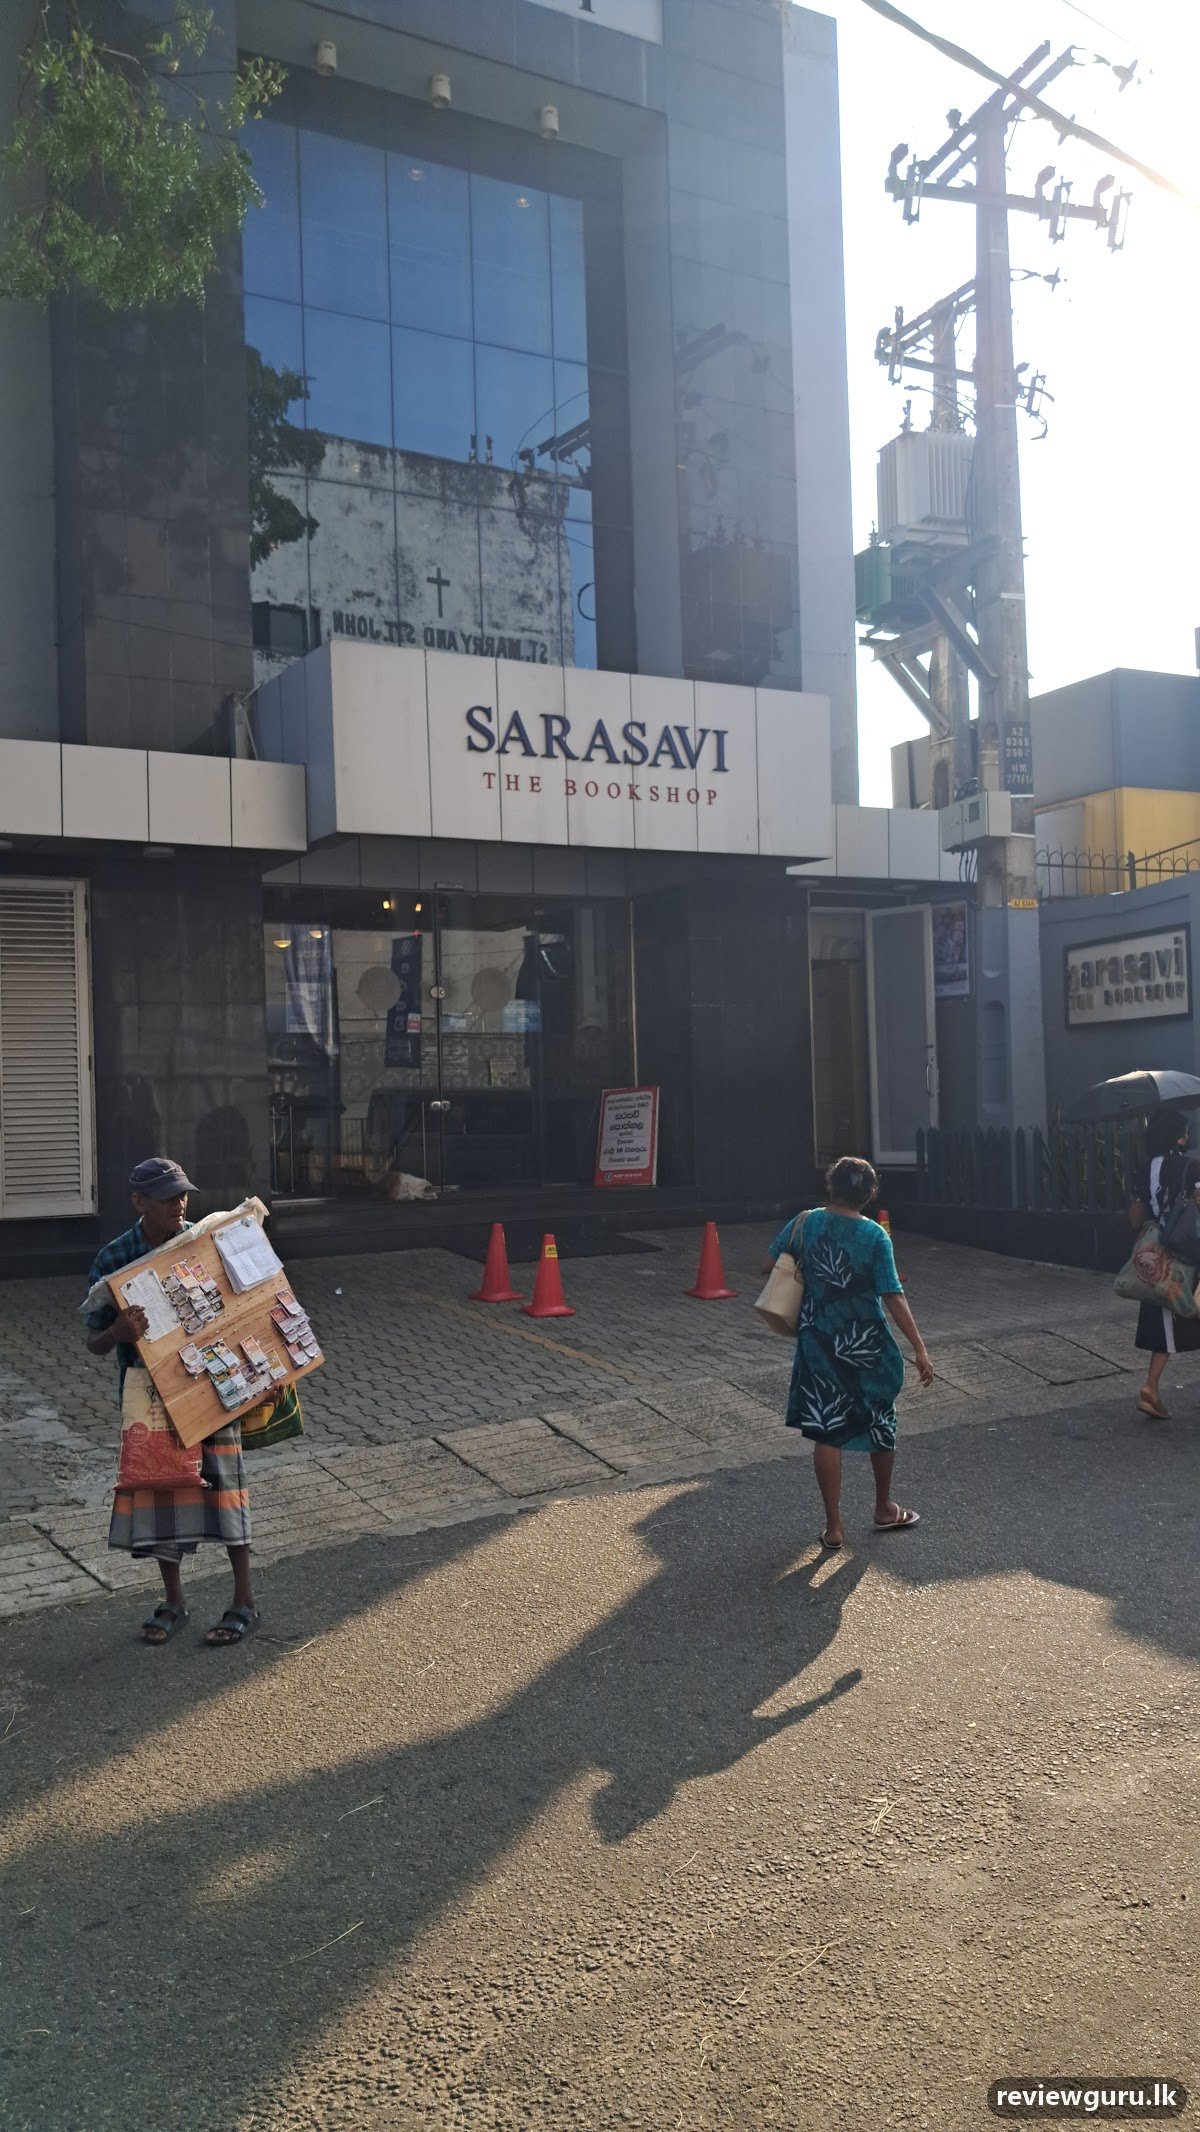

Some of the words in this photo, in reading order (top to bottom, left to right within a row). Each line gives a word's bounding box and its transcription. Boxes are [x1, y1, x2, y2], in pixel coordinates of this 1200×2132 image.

[466, 705, 729, 772] SARASAVI
[483, 771, 543, 794] THE
[564, 778, 719, 806] BOOKSHOP
[1067, 936, 1184, 993] sarasavi
